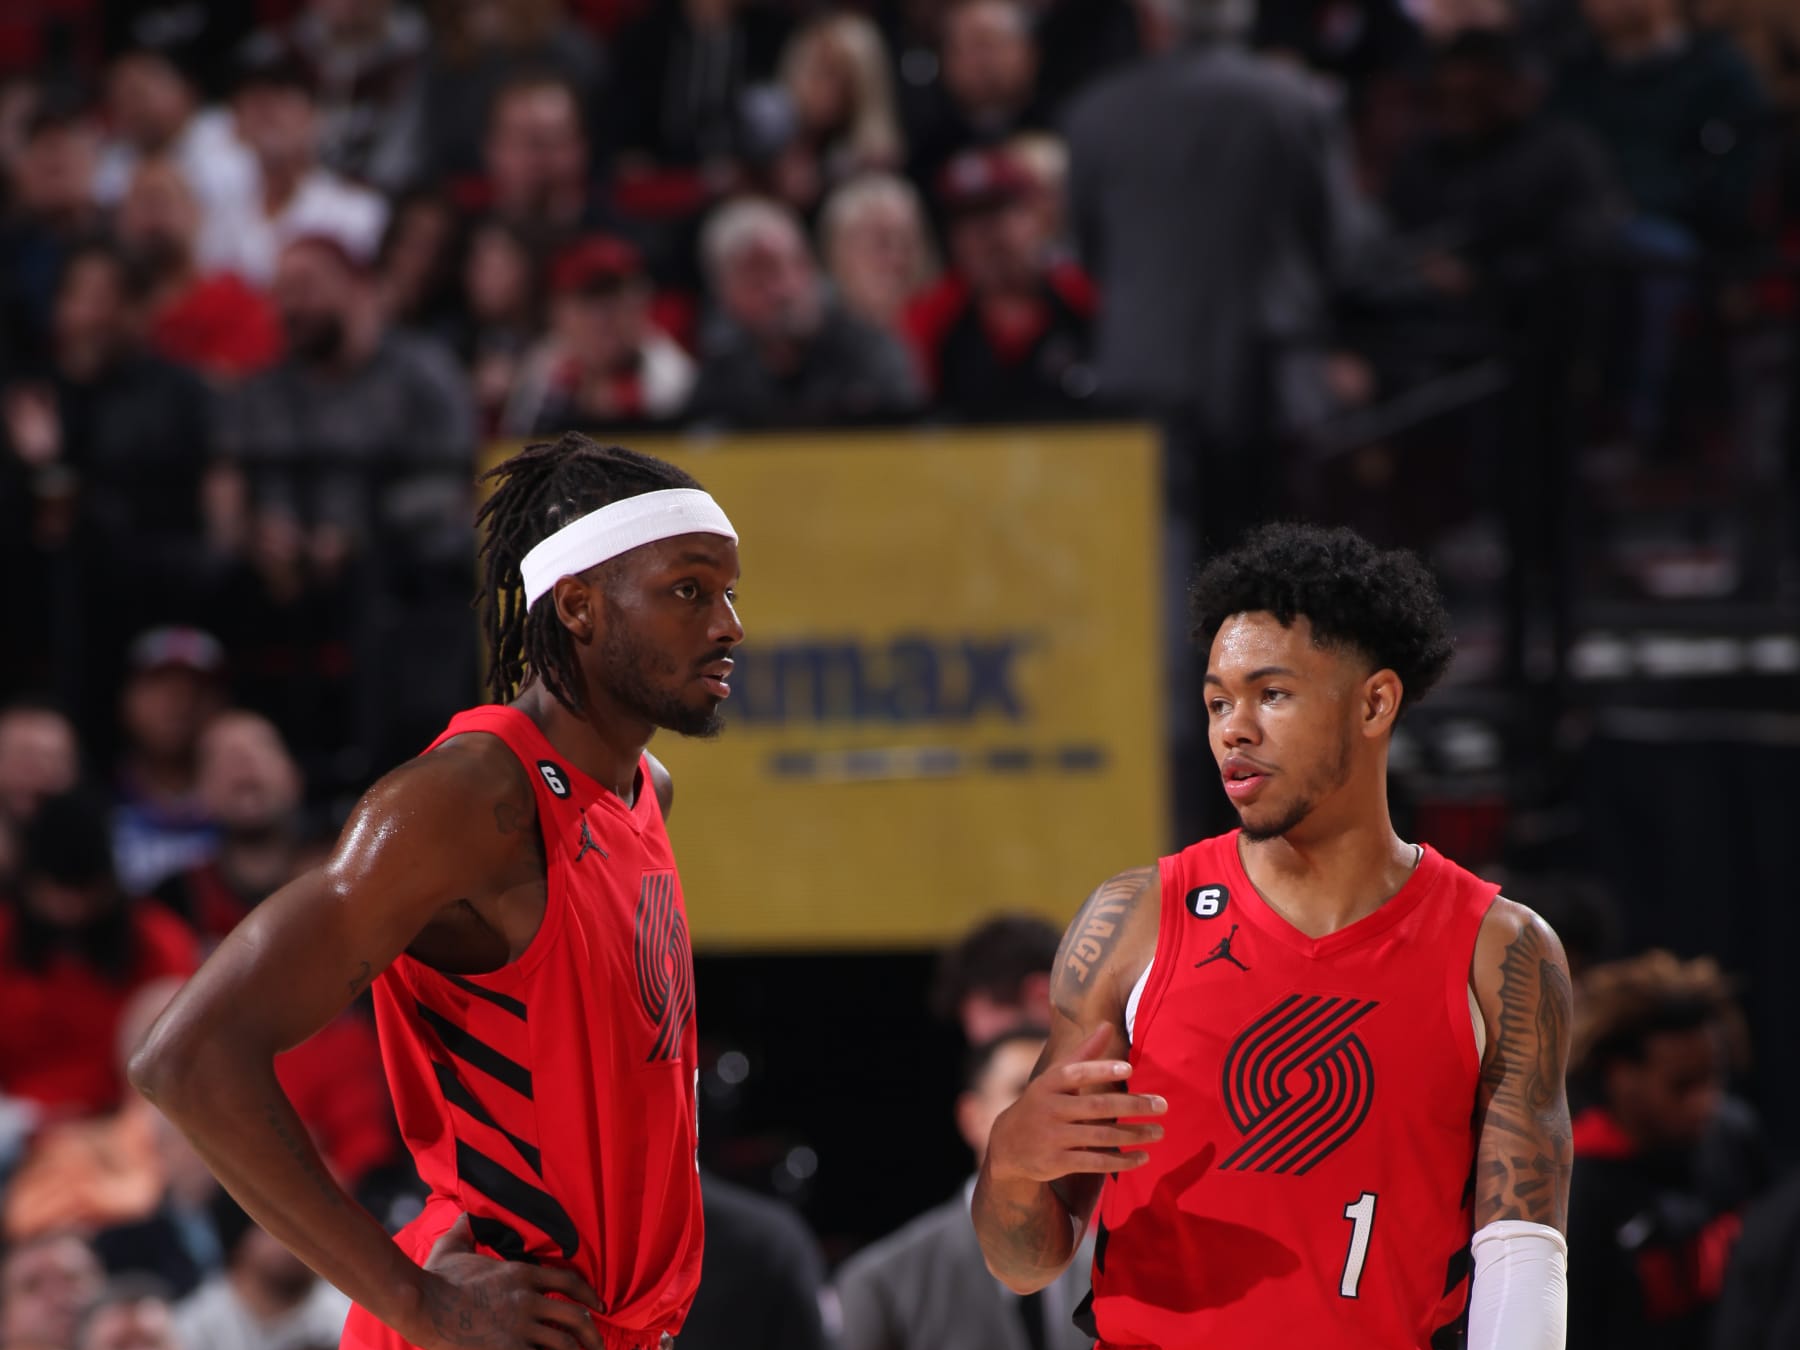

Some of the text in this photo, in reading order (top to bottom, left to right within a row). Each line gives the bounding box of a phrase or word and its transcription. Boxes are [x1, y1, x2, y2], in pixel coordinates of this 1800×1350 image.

[540, 766, 566, 794] 6
[1195, 889, 1221, 915] 6
[1339, 1190, 1378, 1299] 1
